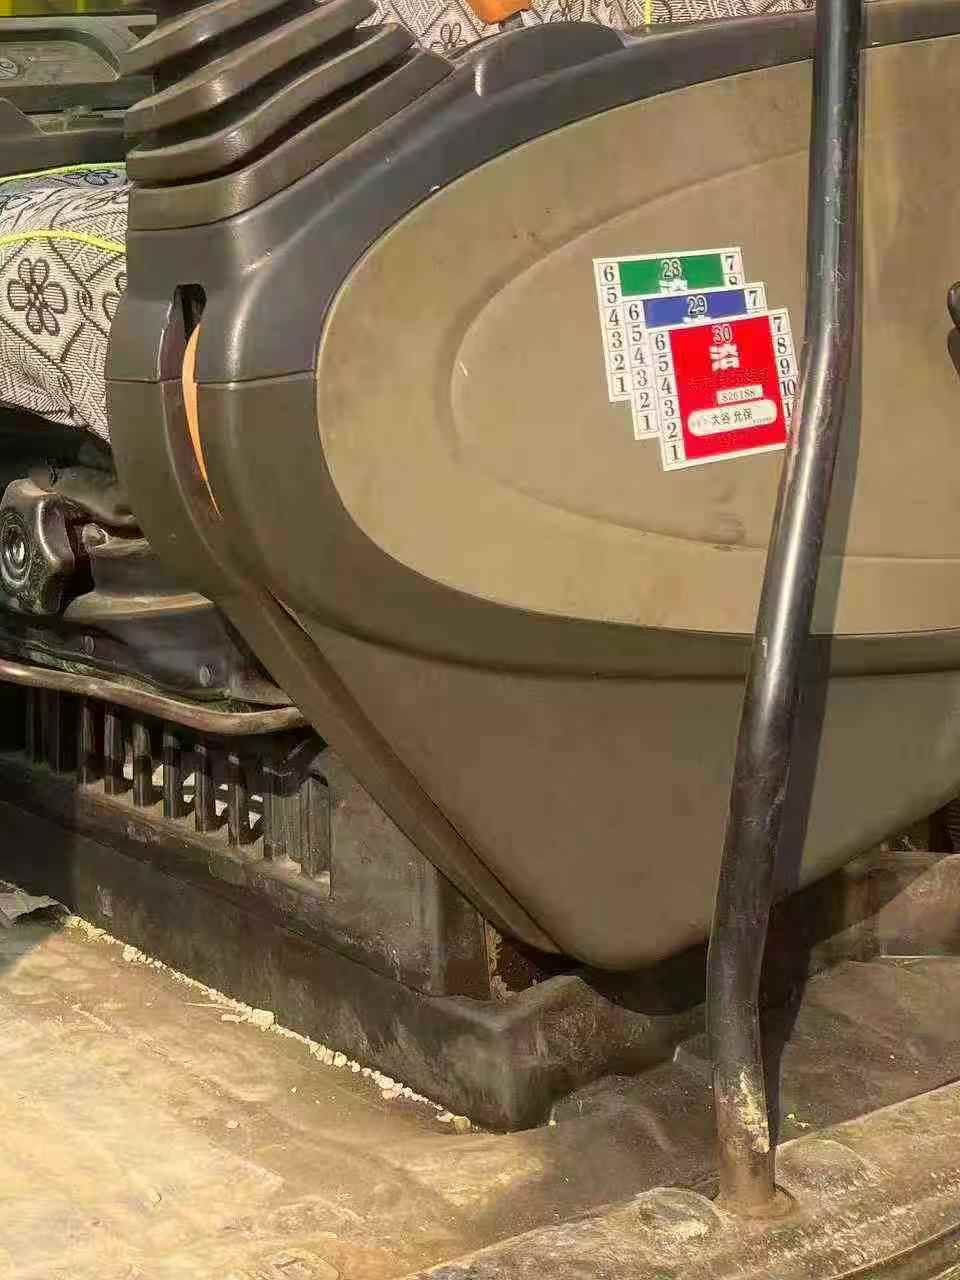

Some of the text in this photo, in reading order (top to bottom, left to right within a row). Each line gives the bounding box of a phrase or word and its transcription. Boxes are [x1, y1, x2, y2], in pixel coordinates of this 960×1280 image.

[725, 255, 735, 271] 7
[604, 265, 615, 282] 6
[607, 287, 617, 303] 5
[748, 290, 759, 306] 7
[629, 304, 640, 321] 6
[688, 294, 708, 316] 29
[609, 309, 620, 327] 4
[773, 316, 784, 333] 7
[612, 331, 623, 349] 3
[632, 325, 642, 342] 5
[712, 323, 733, 344] 30
[656, 334, 666, 351] 6
[777, 337, 787, 355] 8
[613, 353, 624, 370] 2
[634, 347, 645, 365] 4
[658, 354, 668, 372] 5
[780, 357, 790, 377] 9
[615, 376, 626, 393] 1
[637, 369, 648, 386] 3
[661, 377, 672, 395] 4
[640, 392, 650, 410] 2
[664, 400, 675, 417] 3
[643, 415, 651, 431] 1
[667, 422, 678, 440] 2
[670, 444, 680, 462] 1
